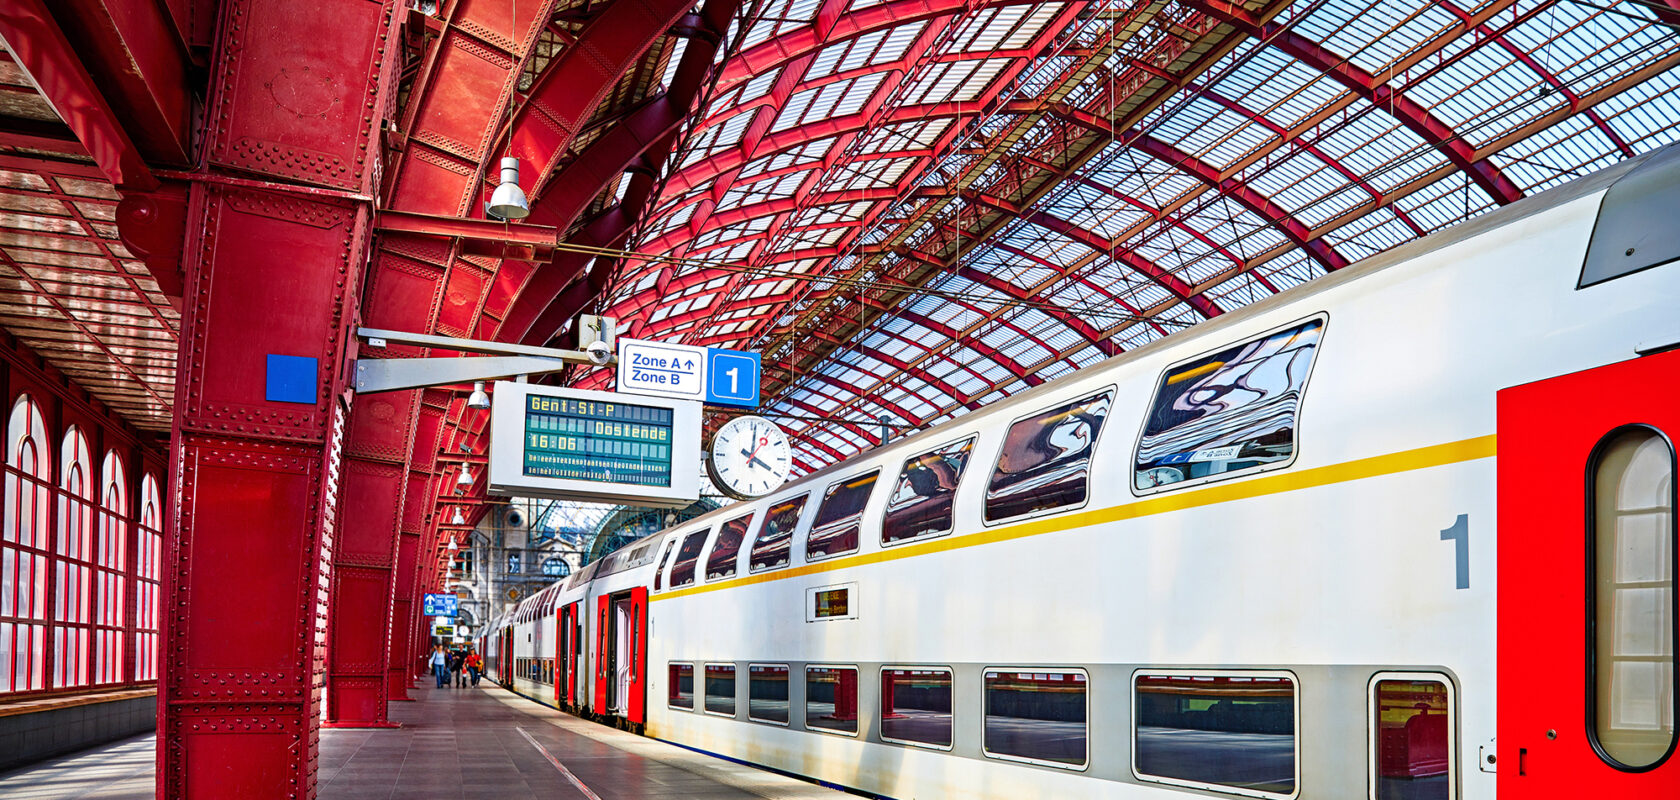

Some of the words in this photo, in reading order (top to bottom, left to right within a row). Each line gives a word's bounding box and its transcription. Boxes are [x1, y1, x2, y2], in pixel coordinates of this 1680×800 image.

[632, 353, 667, 367] Zone
[671, 358, 681, 369] A
[632, 369, 667, 384] Zone
[670, 374, 680, 385] B
[726, 367, 739, 394] 1
[532, 397, 614, 417] Gent-St-P
[596, 422, 667, 440] Oostende
[530, 434, 576, 450] 16:06
[1440, 513, 1470, 590] 1
